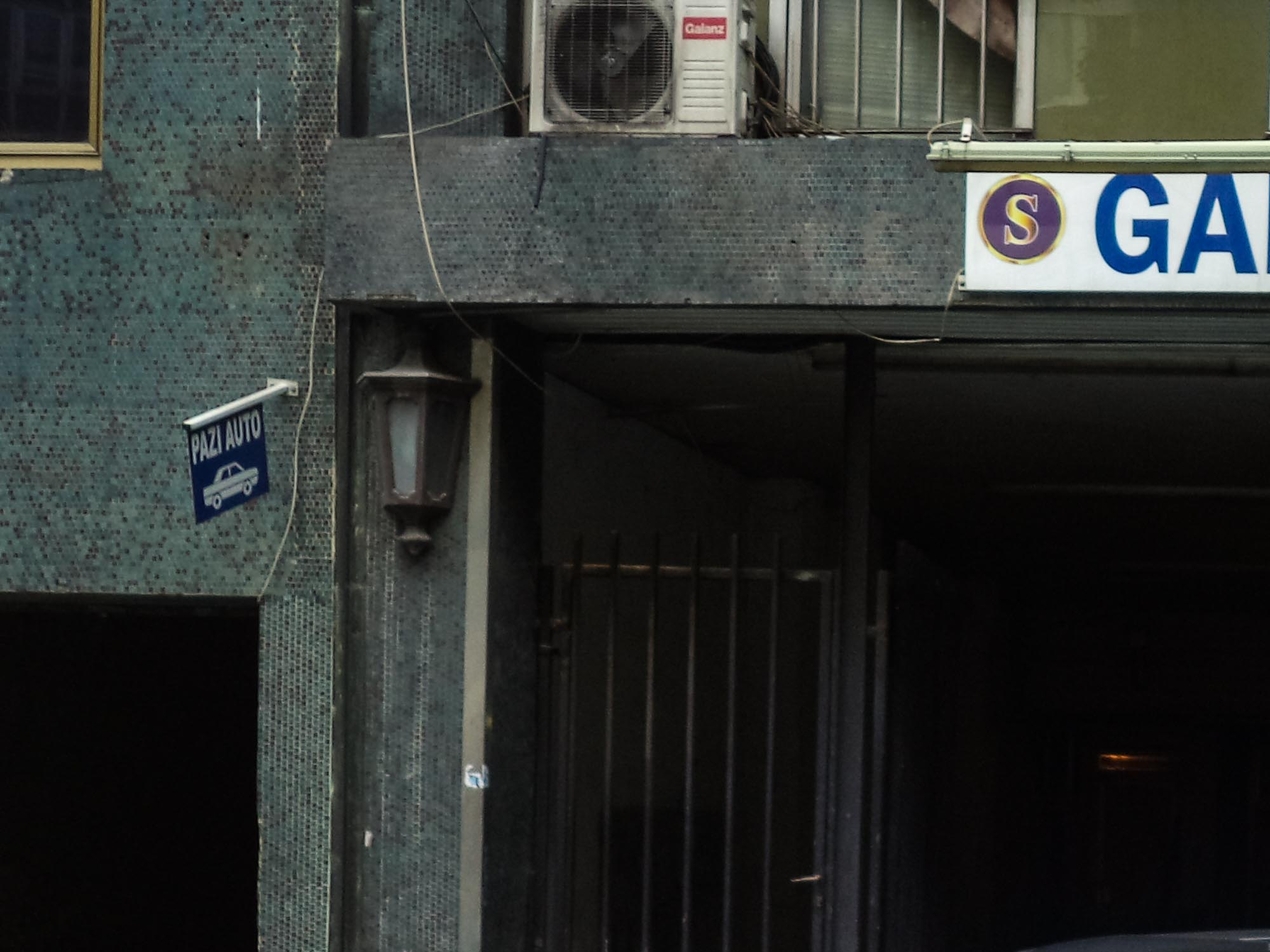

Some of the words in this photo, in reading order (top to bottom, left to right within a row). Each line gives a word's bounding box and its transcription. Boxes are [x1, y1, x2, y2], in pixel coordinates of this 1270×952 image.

[685, 23, 725, 34] Galanz
[1004, 194, 1039, 245] S
[190, 424, 222, 465] PAZI
[225, 409, 261, 451] AUTO
